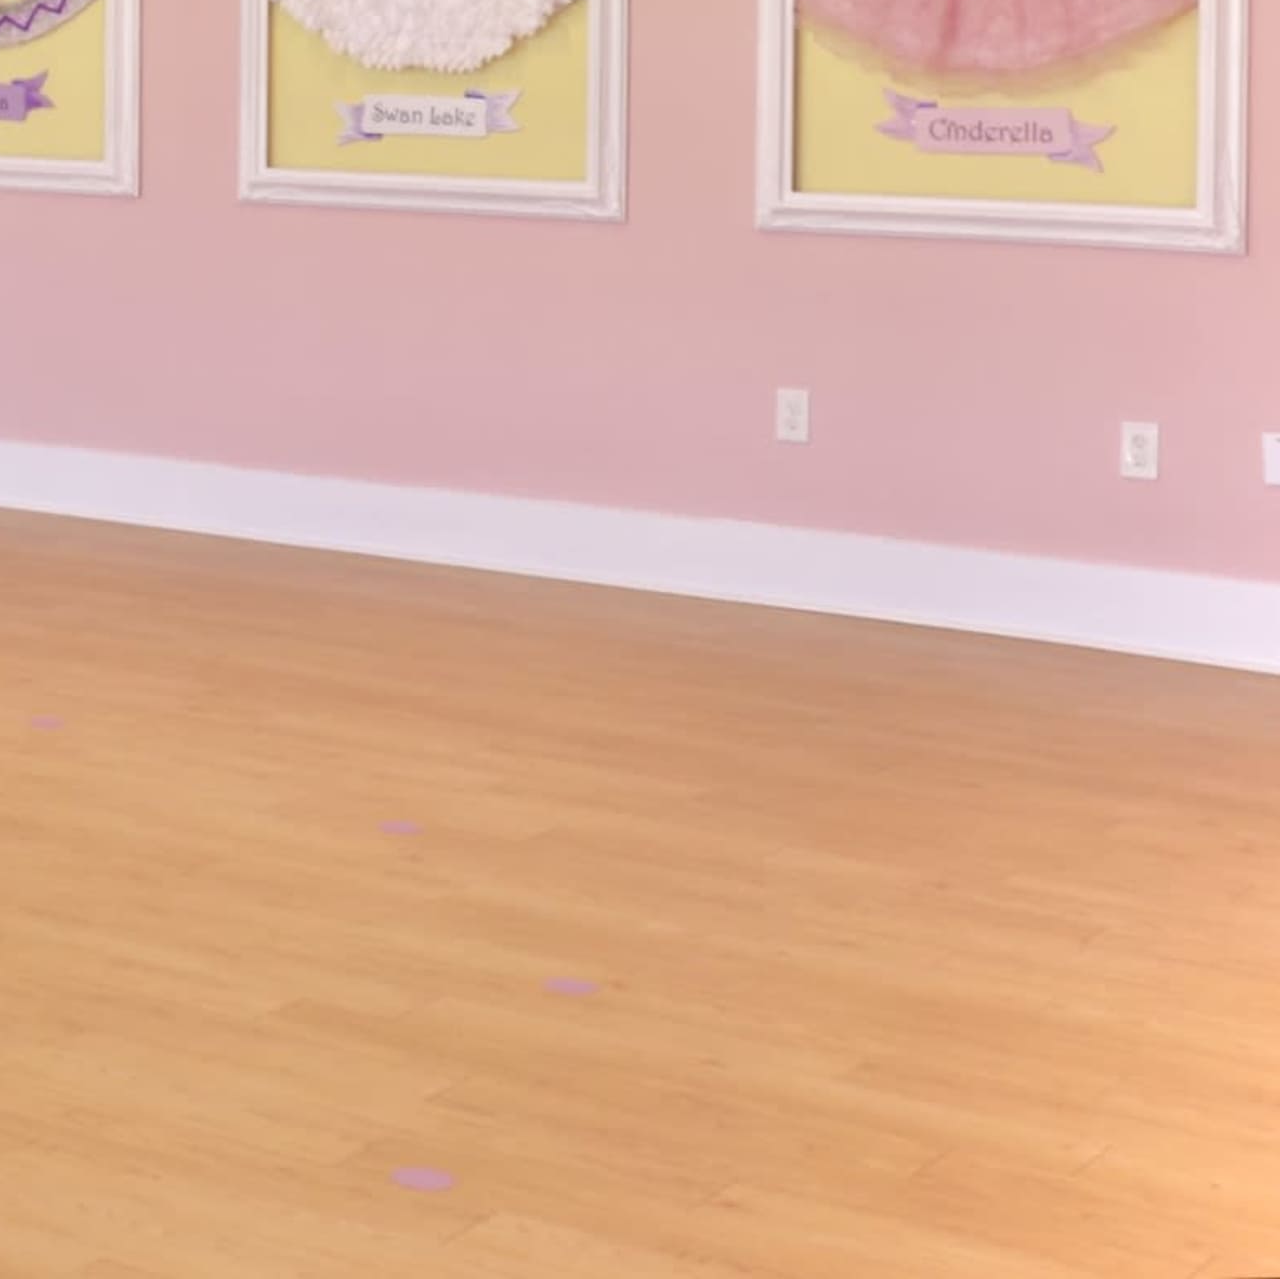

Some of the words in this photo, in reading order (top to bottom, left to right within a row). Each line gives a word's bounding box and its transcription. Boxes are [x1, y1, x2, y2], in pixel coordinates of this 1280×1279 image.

[372, 101, 424, 125] Swan
[429, 105, 477, 127] Lake
[928, 117, 1054, 144] Cinderella
